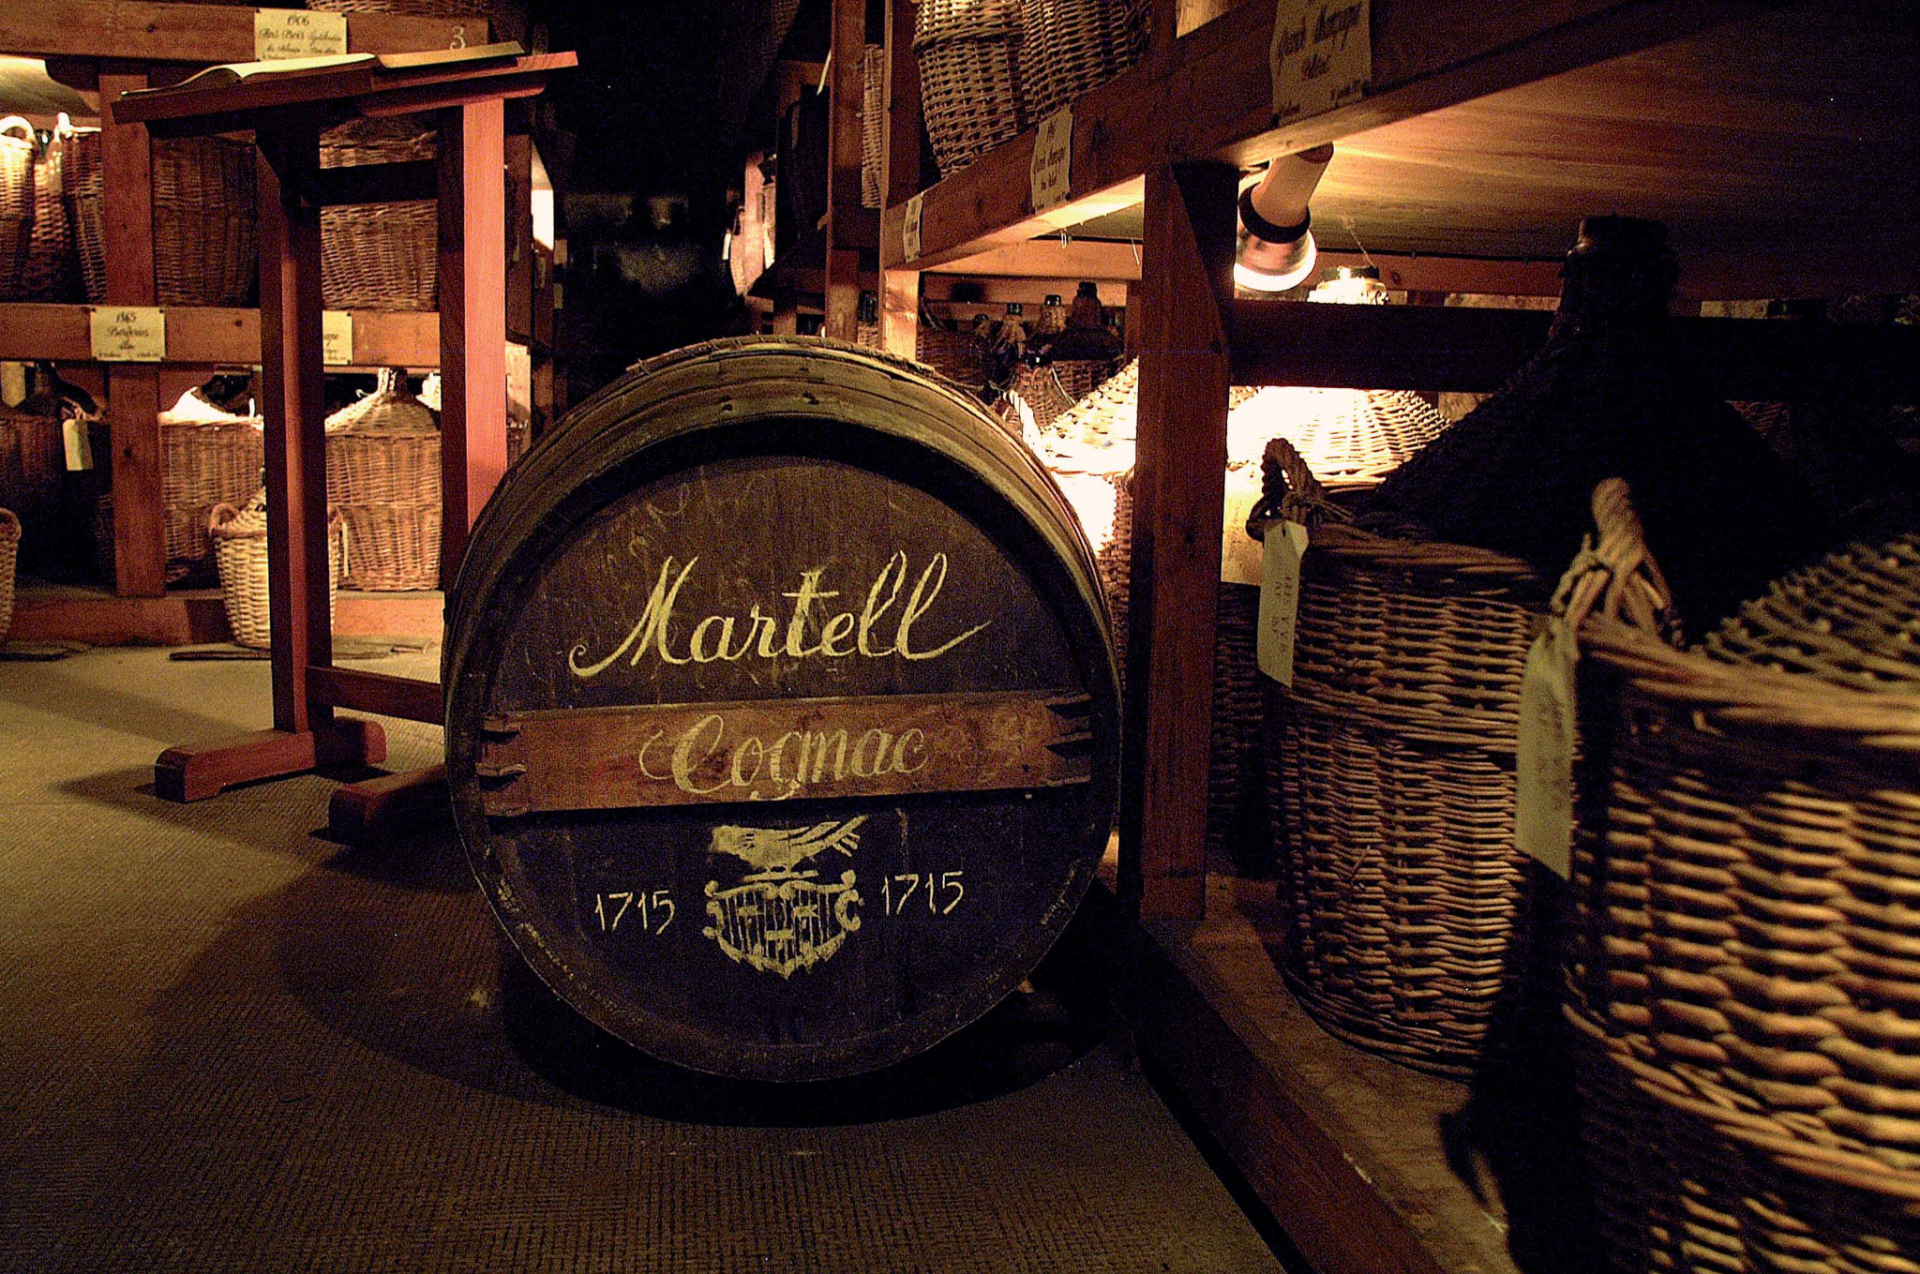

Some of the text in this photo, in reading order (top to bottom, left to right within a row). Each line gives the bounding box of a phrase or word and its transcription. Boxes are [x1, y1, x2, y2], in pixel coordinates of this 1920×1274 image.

[450, 26, 467, 50] 3
[568, 550, 992, 677] Martell
[638, 714, 930, 802] Cognac
[593, 889, 676, 935] 1715
[881, 870, 966, 916] 1715
